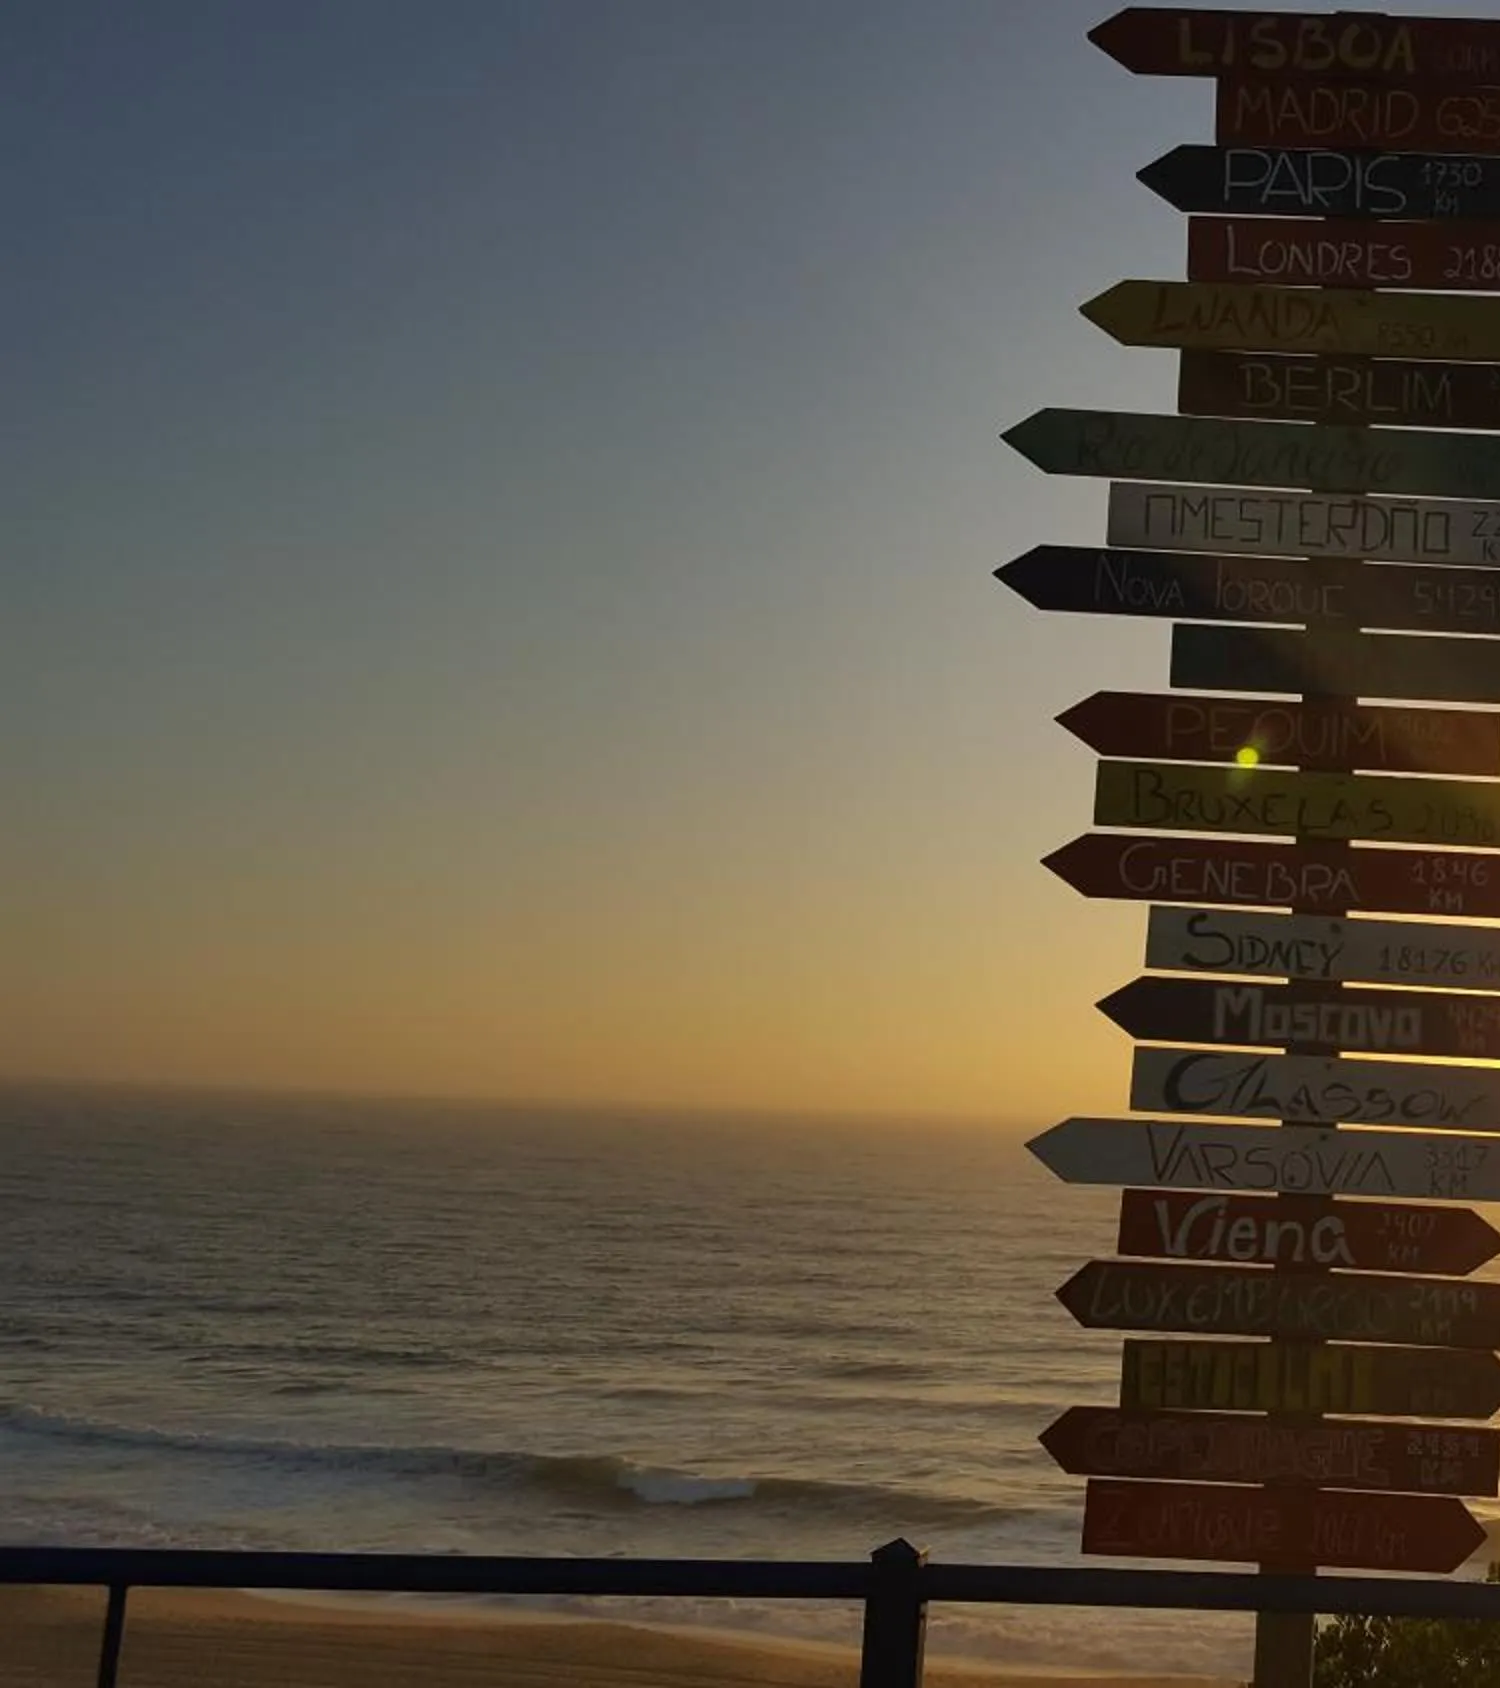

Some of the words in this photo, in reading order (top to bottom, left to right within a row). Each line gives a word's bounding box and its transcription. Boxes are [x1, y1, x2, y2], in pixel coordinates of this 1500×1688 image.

[1177, 17, 1416, 74] LISBOA
[1235, 87, 1419, 141] MADRID
[1223, 149, 1407, 213] PARIS
[1418, 160, 1482, 187] 1730
[1226, 223, 1412, 281] LONDRES
[1149, 286, 1339, 341] LUANDA
[1240, 361, 1453, 419] BERLIM
[1166, 702, 1386, 760] PEQUIM
[1133, 769, 1395, 833] BRUXELAS
[1119, 842, 1360, 902] GENEBRA
[1407, 857, 1489, 887] 1846
[1184, 914, 1345, 978] SIDNEY
[1378, 948, 1469, 974] 18176
[1153, 1197, 1357, 1266] Viena
